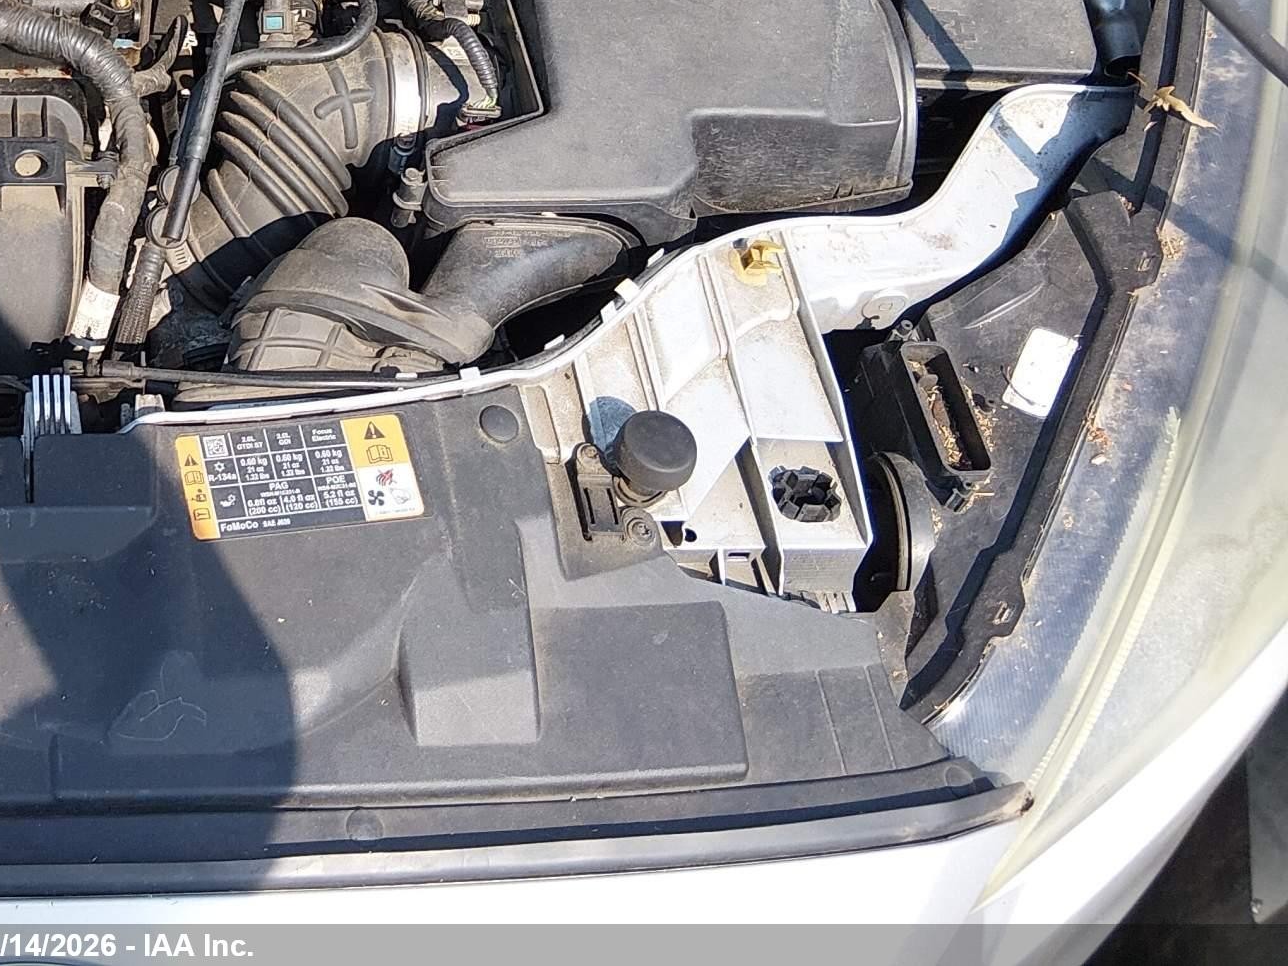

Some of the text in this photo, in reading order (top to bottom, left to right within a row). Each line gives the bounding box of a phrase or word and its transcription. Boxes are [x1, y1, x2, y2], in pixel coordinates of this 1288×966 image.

[312, 434, 337, 442] Electric
[275, 452, 303, 463] 0.60 kg
[314, 449, 343, 459] 0.60 kg
[257, 456, 268, 466] kg
[207, 473, 237, 482] R-134a
[326, 474, 346, 485] POE
[269, 481, 289, 491] PAG
[283, 495, 296, 504] 4.0
[296, 494, 304, 502] fl
[323, 489, 355, 499] 5.2 fl oz
[266, 498, 277, 506] oz
[286, 501, 318, 512] (120 cc)
[325, 496, 358, 508] (155 cc)
[248, 504, 281, 515] (200 cc)
[220, 520, 259, 532] FoMoCo
